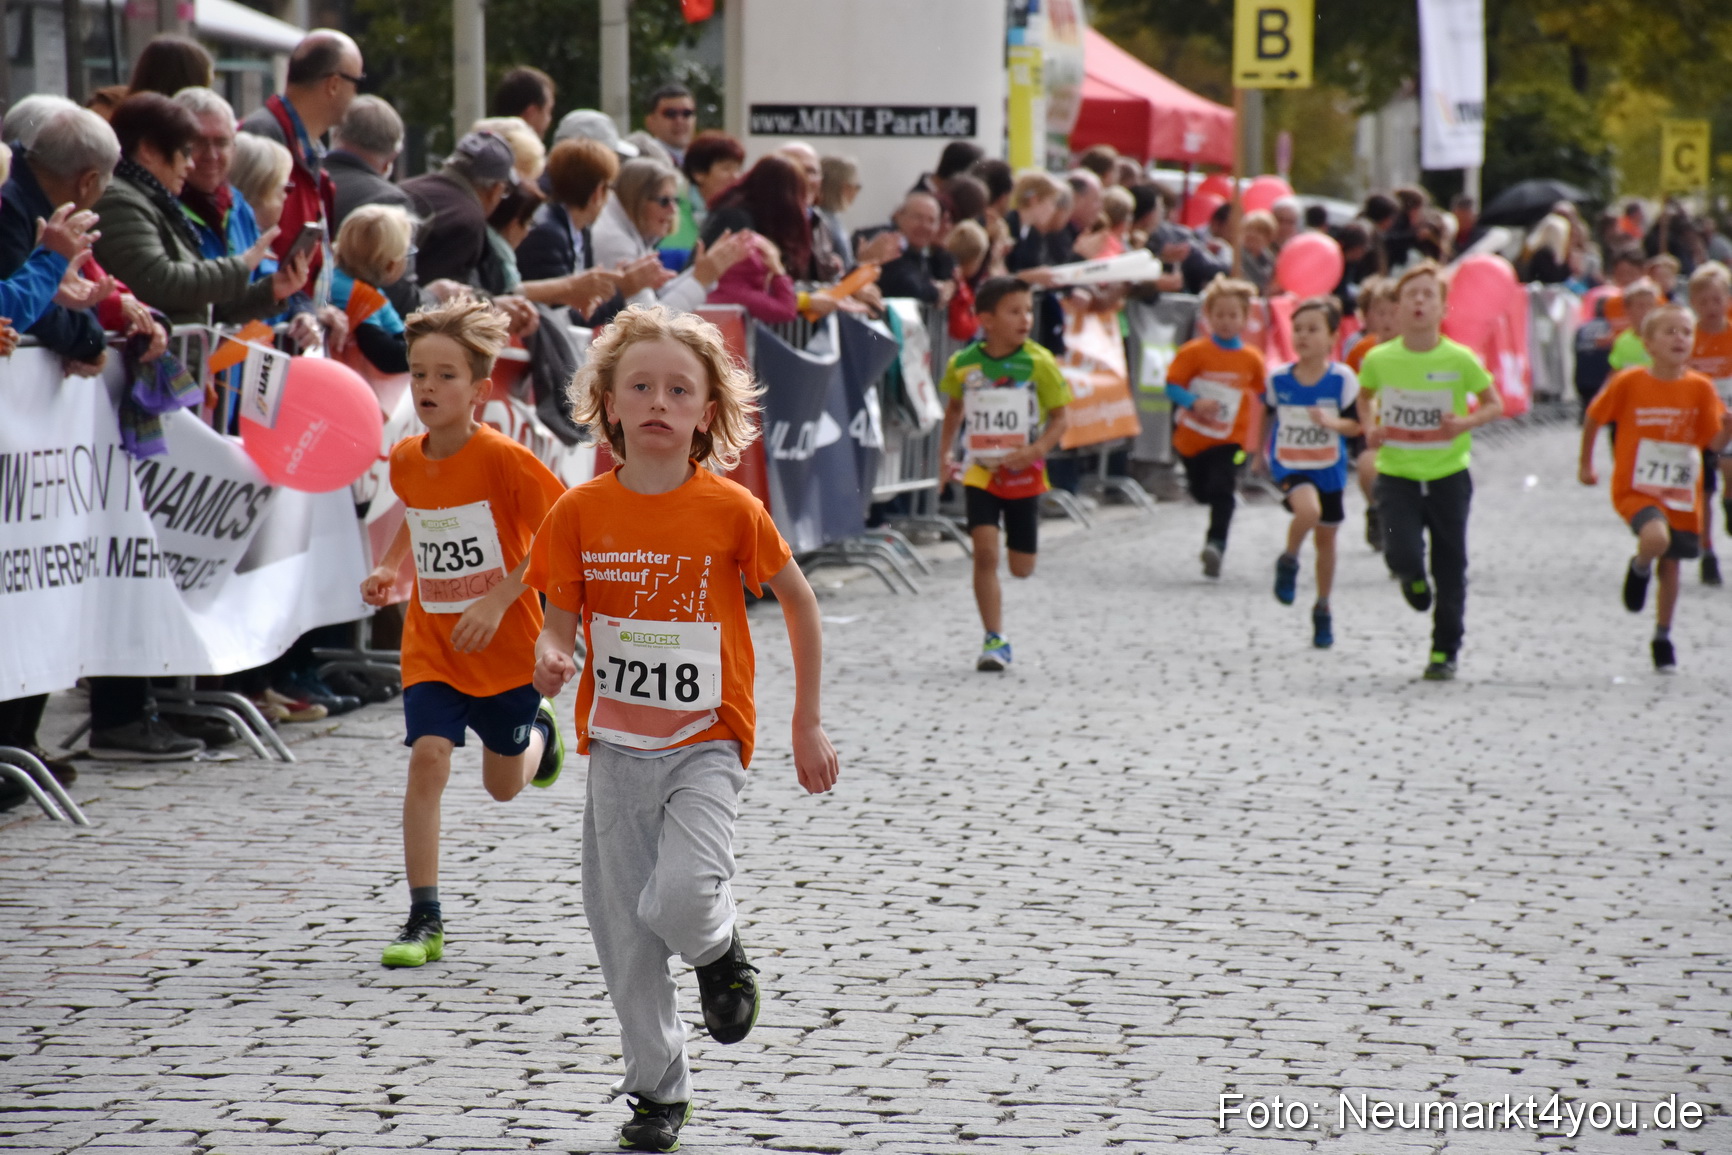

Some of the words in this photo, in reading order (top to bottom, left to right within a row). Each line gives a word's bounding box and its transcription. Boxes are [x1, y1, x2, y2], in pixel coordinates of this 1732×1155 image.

[1257, 8, 1291, 59] B
[1673, 141, 1697, 174] C
[973, 410, 1018, 430] 7140
[1391, 406, 1442, 427] 7038
[419, 536, 484, 573] 7235
[581, 549, 671, 565] Neumarkter
[583, 568, 650, 585] Stadtlauf
[633, 632, 681, 645] BOCK
[608, 655, 700, 702] 7218
